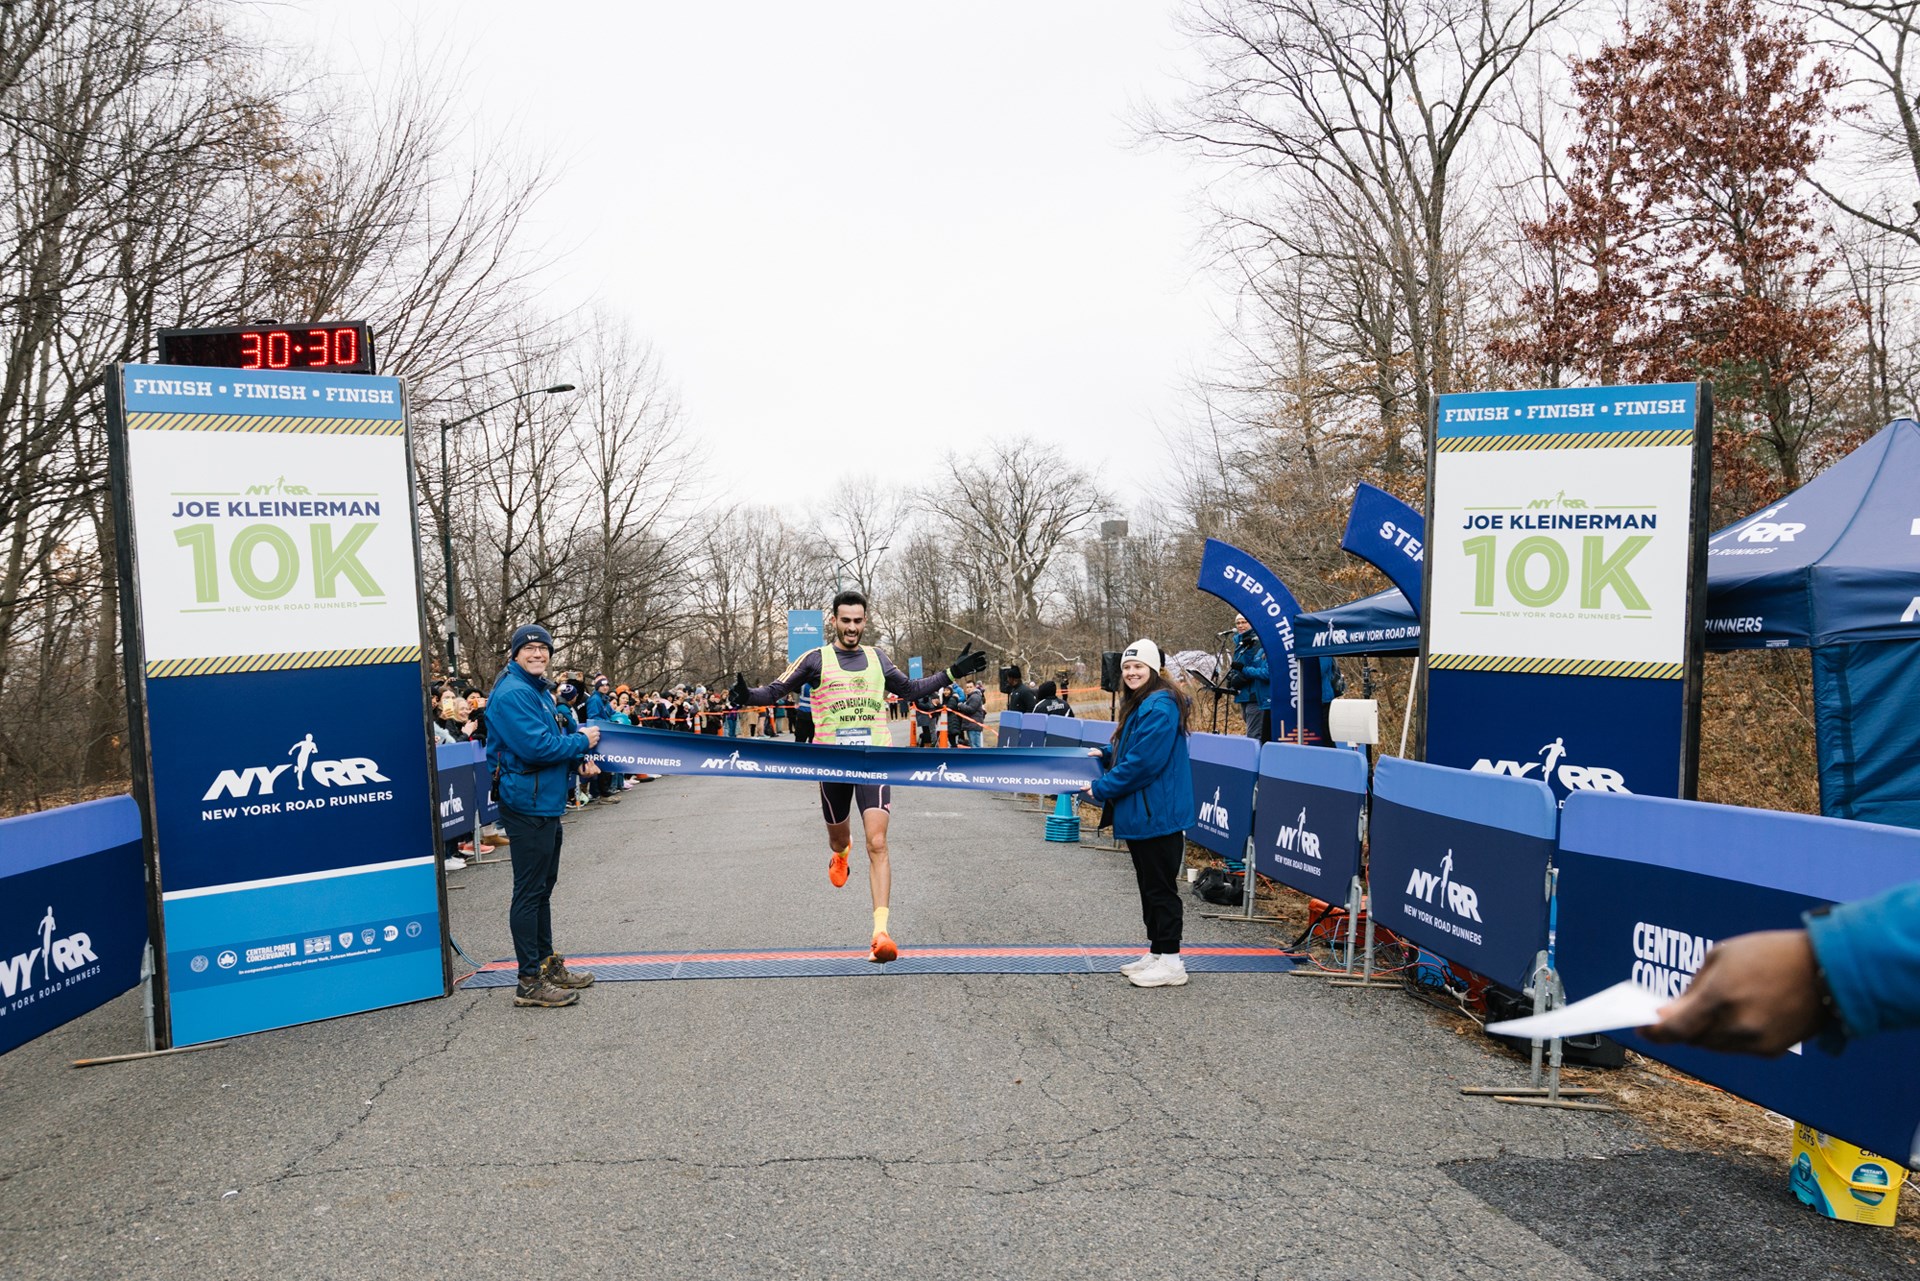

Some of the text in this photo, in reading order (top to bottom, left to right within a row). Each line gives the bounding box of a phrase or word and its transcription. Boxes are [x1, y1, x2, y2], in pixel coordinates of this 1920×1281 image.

[134, 379, 394, 404] FINISH FINISH FINISH
[1444, 399, 1686, 422] FINISH FINISH FINISH
[172, 501, 380, 518] JOE KLEINERMAN
[1462, 514, 1657, 530] JOE KLEINERMAN
[173, 522, 386, 604] 10K
[1462, 535, 1652, 610] 10K
[228, 601, 358, 613] NEW YORK ROAD RUNNERS
[1224, 565, 1264, 594] STEP
[1261, 592, 1280, 617] TO
[1276, 616, 1294, 650] THE
[1312, 630, 1348, 647] NYRR
[1350, 631, 1366, 643] NEW
[1366, 630, 1384, 642] YORK
[1385, 627, 1405, 640] ROAD
[608, 754, 635, 764] ROAD
[637, 757, 682, 767] RUNNERS
[764, 765, 786, 774] NEW
[789, 766, 815, 776] YORK
[817, 768, 844, 778] ROAD
[846, 770, 888, 780] RUNNERS
[201, 756, 392, 800] NYRR
[972, 776, 994, 784] NEW
[996, 776, 1022, 786] YORK
[1024, 778, 1050, 786] ROAD
[1052, 778, 1090, 787] RUNNER
[202, 790, 393, 821] NEW YORK ROAD RUNNERS
[1199, 802, 1230, 830] NYRR
[1276, 826, 1322, 860] NYRR
[1274, 854, 1322, 876] NEW YORK ROAD RUNNERS
[1406, 868, 1482, 924] NYRR
[1404, 904, 1482, 946] NEW YORK ROAD RUNNERS
[246, 944, 290, 956] CENTRAL PARK
[12, 994, 35, 1012] YORK
[39, 982, 62, 999] ROAD
[66, 965, 100, 987] RUNNERS
[1798, 1130, 1814, 1146] CATS
